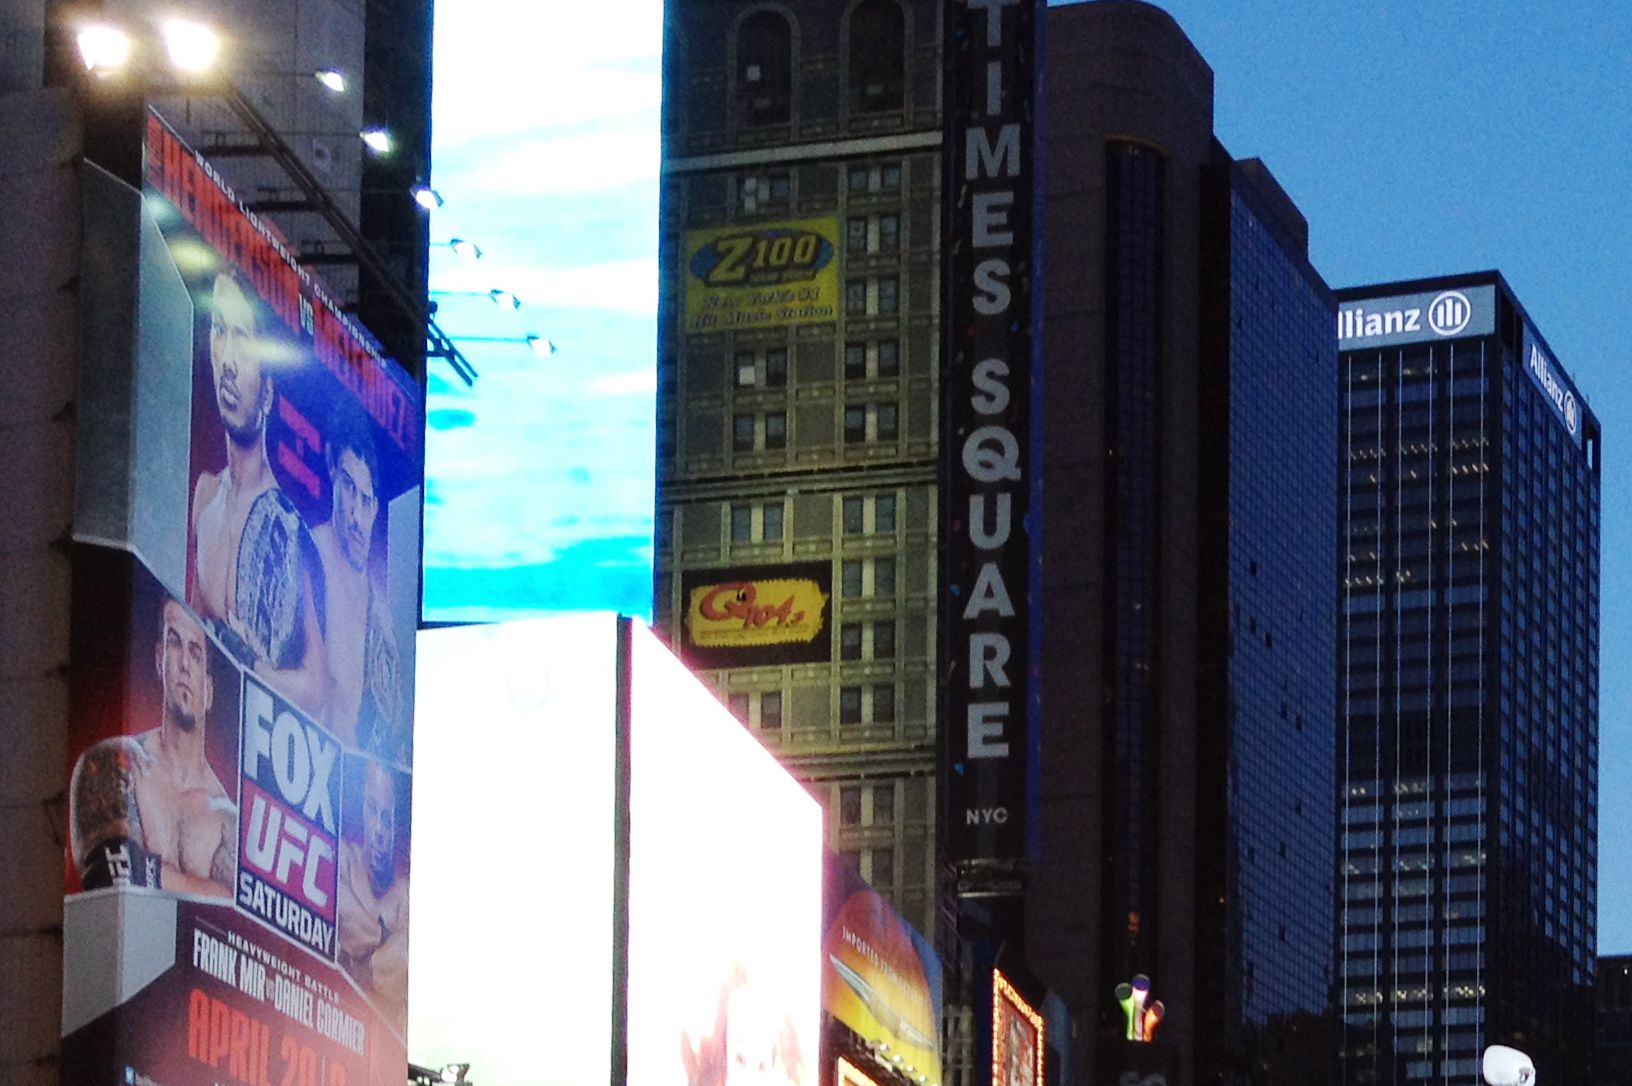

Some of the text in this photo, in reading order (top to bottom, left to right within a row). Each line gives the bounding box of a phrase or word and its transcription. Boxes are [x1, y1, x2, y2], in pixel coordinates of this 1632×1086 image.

[194, 149, 236, 203] WORLD
[707, 234, 817, 283] Z100
[1338, 307, 1421, 340] llianz
[961, 0, 1022, 758] TIMES SQUARE
[1530, 343, 1563, 410] Allianz
[245, 678, 336, 833] FOX
[966, 807, 1009, 825] NYC
[245, 793, 335, 909] UFC
[239, 871, 334, 954] SATURDAY
[227, 930, 302, 978] HEAVYWEIGHT
[193, 928, 238, 986] FRANK
[239, 954, 267, 1004] MIR
[273, 974, 315, 1029] DANIEL
[316, 997, 365, 1057] CORMIER
